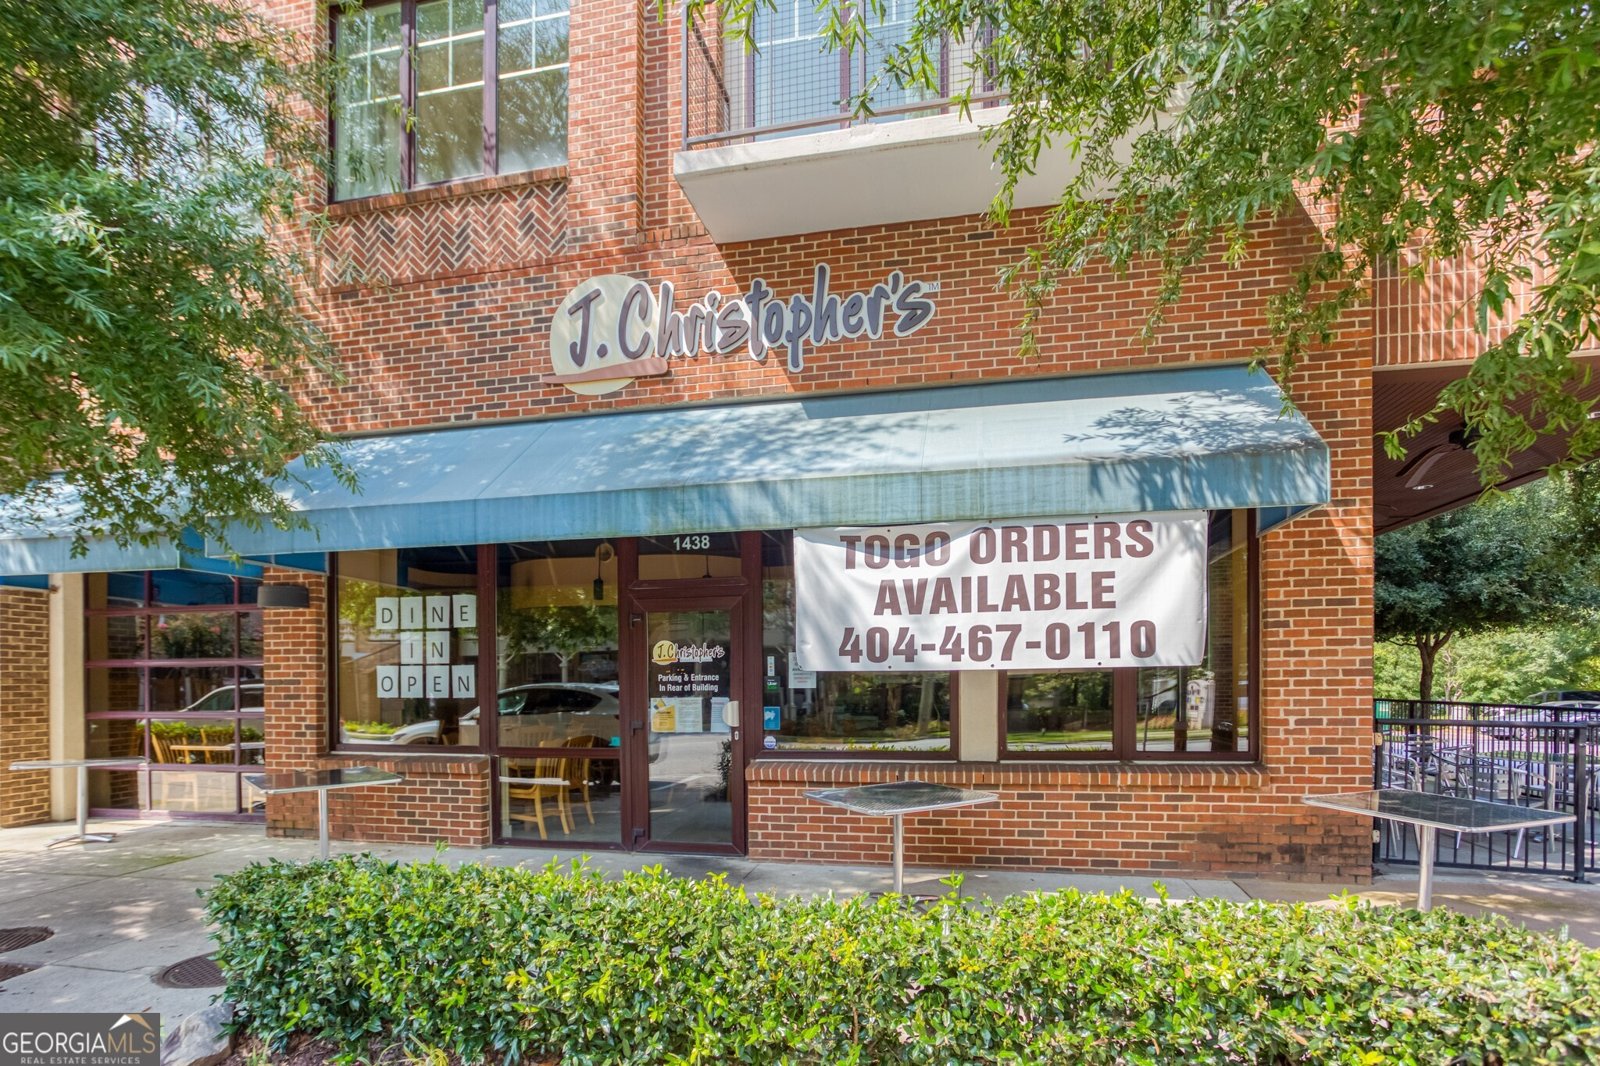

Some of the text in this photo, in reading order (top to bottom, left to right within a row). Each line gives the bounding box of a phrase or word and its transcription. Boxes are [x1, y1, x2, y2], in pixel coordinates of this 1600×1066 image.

[673, 535, 710, 551] 1438
[839, 519, 1154, 570] TOGO ORDERS
[873, 571, 1116, 616] AVAILABLE
[381, 605, 469, 624] DINE
[410, 642, 444, 658] IN
[838, 620, 1157, 664] 404-467-0110
[381, 676, 470, 692] OPEN
[658, 674, 682, 682] Parking
[692, 684, 719, 692] Building
